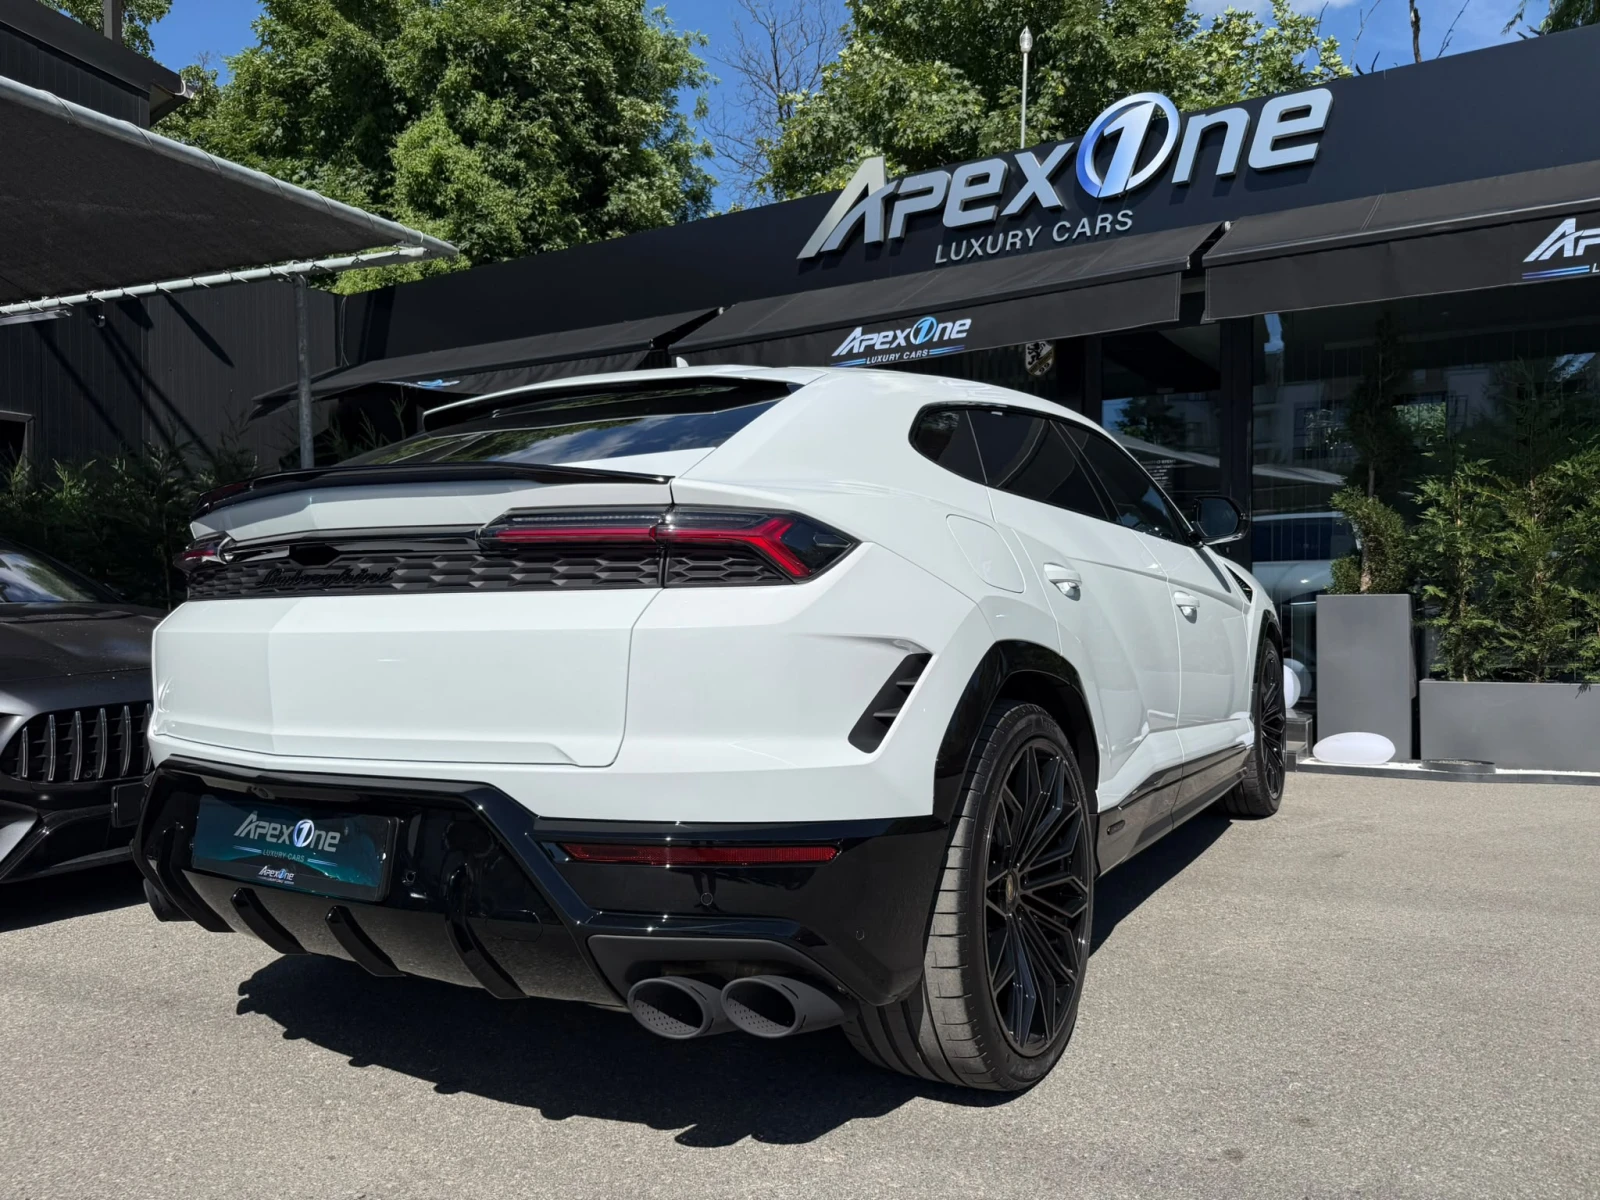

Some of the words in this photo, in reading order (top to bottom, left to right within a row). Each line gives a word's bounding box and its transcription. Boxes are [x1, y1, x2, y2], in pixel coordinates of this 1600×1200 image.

[935, 225, 1042, 264] LUXURY
[1053, 209, 1133, 242] CARS
[866, 352, 900, 365] LUXURY
[903, 349, 928, 360] CARS
[262, 849, 287, 860] LUXURY
[287, 852, 305, 863] CARS
